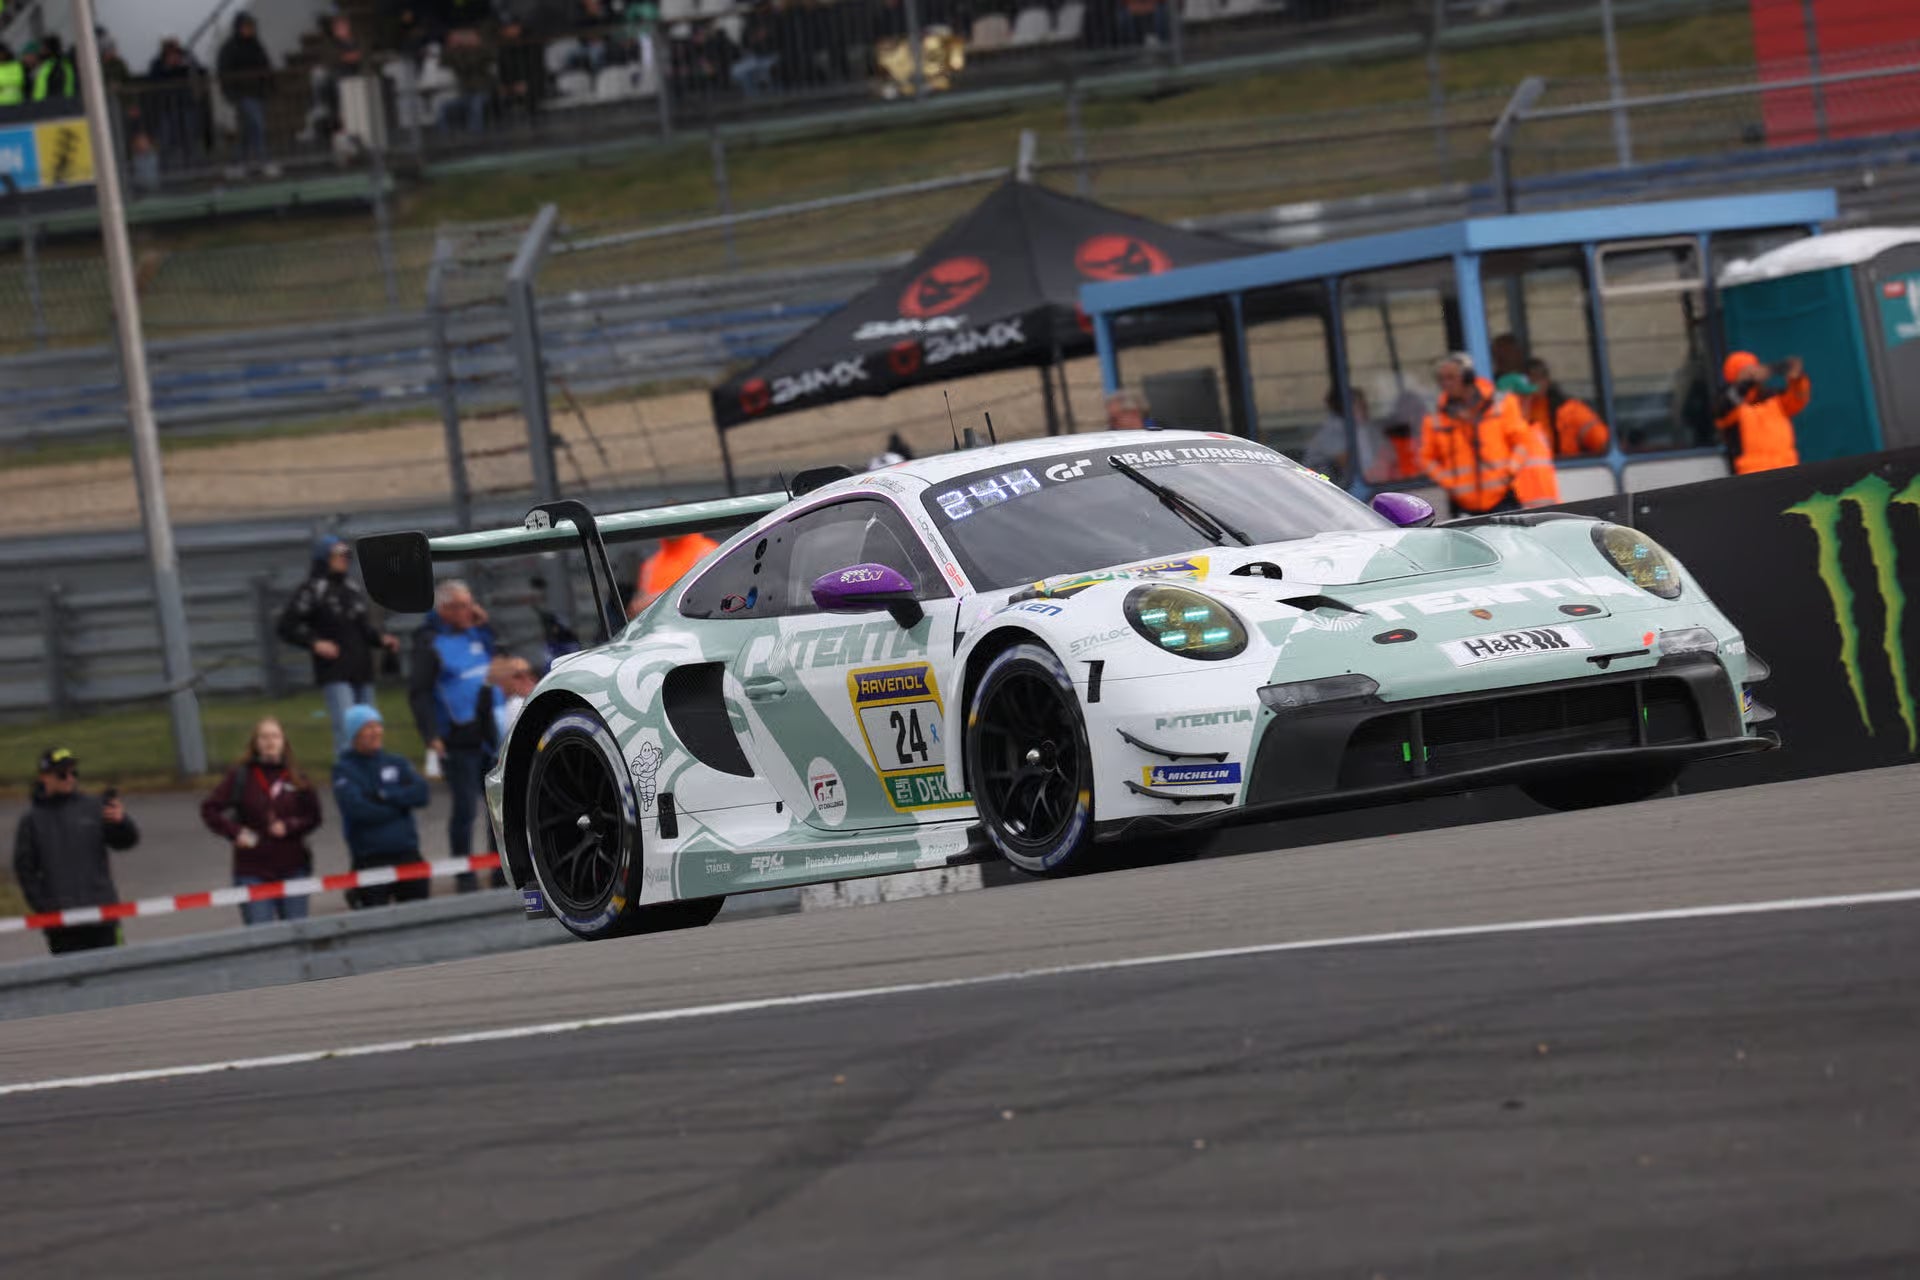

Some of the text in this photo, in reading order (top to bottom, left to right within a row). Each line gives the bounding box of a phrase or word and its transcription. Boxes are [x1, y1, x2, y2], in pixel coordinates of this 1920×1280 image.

[1107, 447, 1282, 468] GRAN TURISMO
[846, 569, 884, 584] KW
[945, 562, 964, 588] GP
[1070, 626, 1131, 652] STALOC
[1462, 633, 1532, 657] H&R
[861, 675, 923, 695] RAVENOL
[890, 708, 928, 764] 24
[1168, 769, 1229, 781] MICHELIN
[916, 773, 974, 802] DEK
[805, 856, 833, 868] Porsche
[864, 850, 898, 862] Dortd
